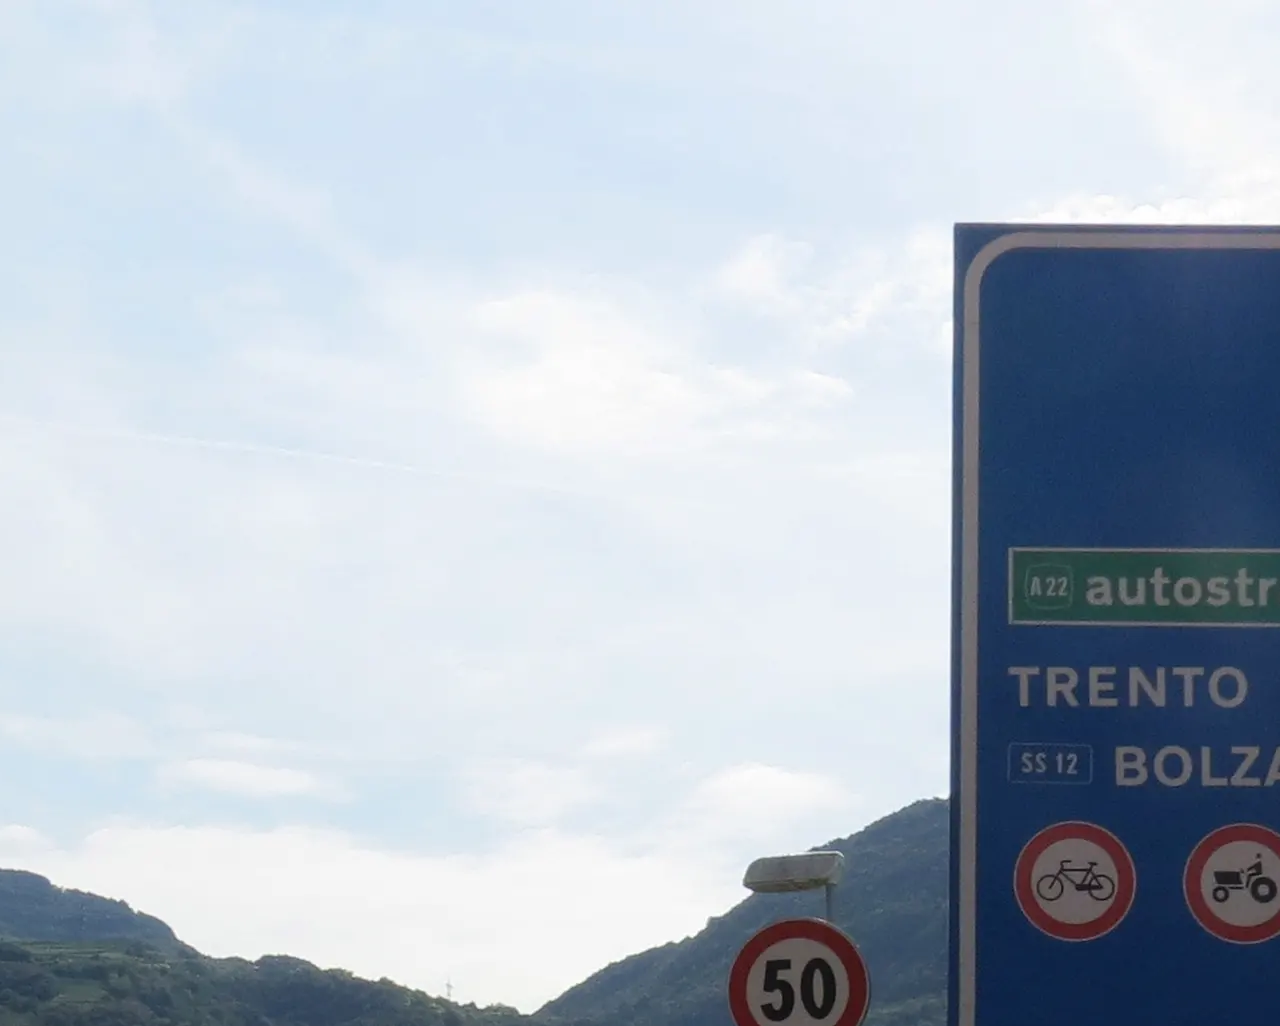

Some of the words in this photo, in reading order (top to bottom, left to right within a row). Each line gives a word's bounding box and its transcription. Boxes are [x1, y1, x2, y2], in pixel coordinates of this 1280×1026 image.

[1007, 666, 1249, 709] TRENTO
[1021, 752, 1047, 773] SS
[1055, 752, 1078, 775] 12
[760, 957, 837, 1022] 50
